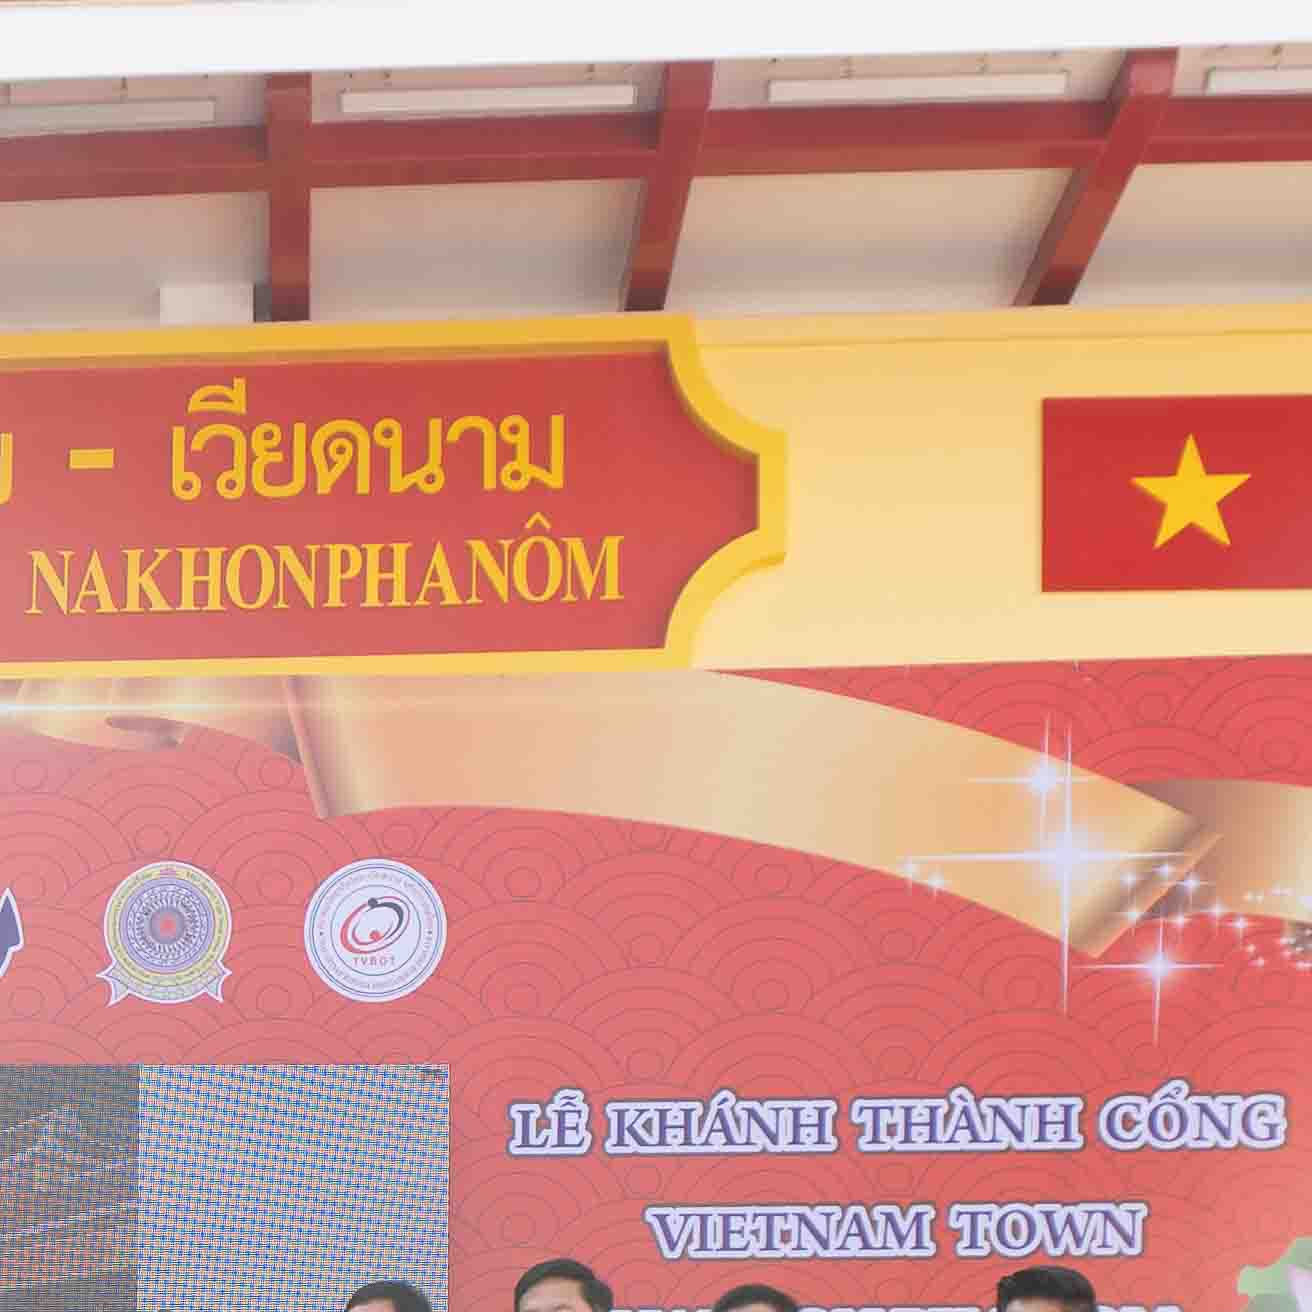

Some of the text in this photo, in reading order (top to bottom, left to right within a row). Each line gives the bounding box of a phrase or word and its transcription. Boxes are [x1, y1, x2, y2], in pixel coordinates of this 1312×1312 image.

[168, 378, 568, 502] เวียดนาม
[24, 512, 622, 620] NAKHONPHANÔM
[610, 1092, 833, 1147] KHÁNH
[858, 1087, 1079, 1145] THÀNH
[1104, 1085, 1283, 1146] CỔNG
[652, 1206, 1147, 1254] VIETNAM TOWN
